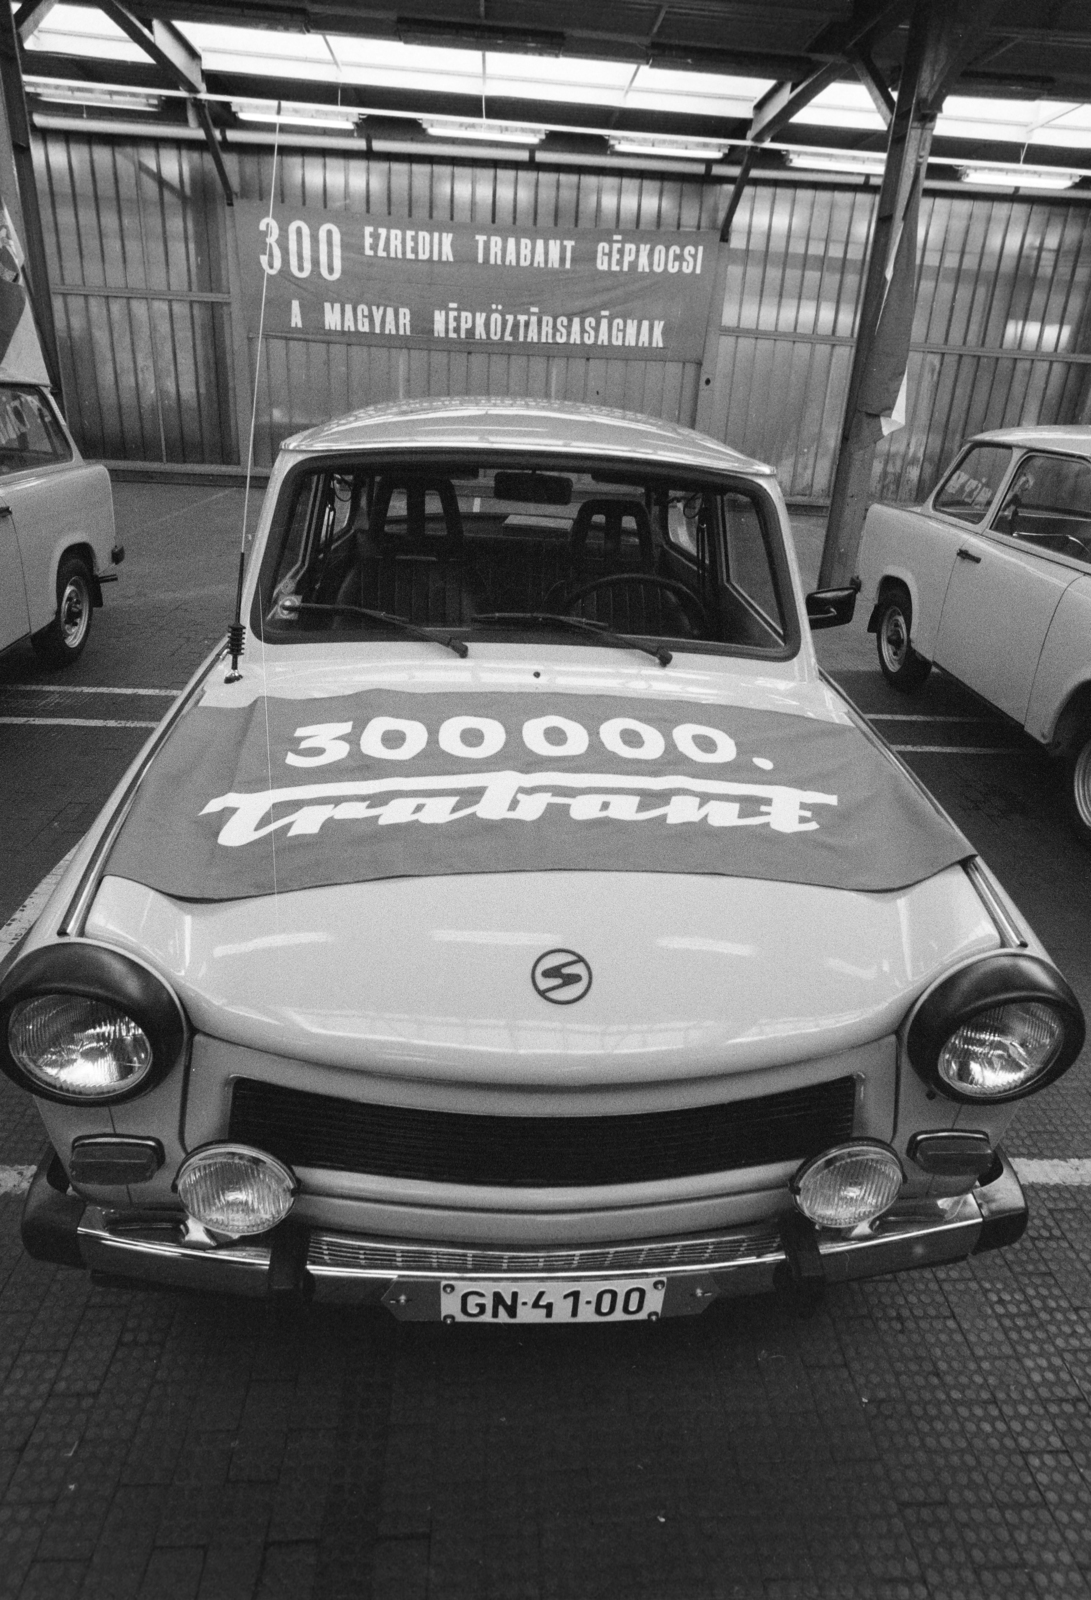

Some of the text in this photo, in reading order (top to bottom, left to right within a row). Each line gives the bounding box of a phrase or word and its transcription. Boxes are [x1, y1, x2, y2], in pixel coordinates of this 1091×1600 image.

[259, 217, 342, 281] 300
[364, 226, 454, 262] EZREDIK
[475, 235, 575, 269] TRABANT
[291, 300, 302, 328] A
[324, 302, 411, 335] MAGYAR
[199, 771, 837, 846] Trabant
